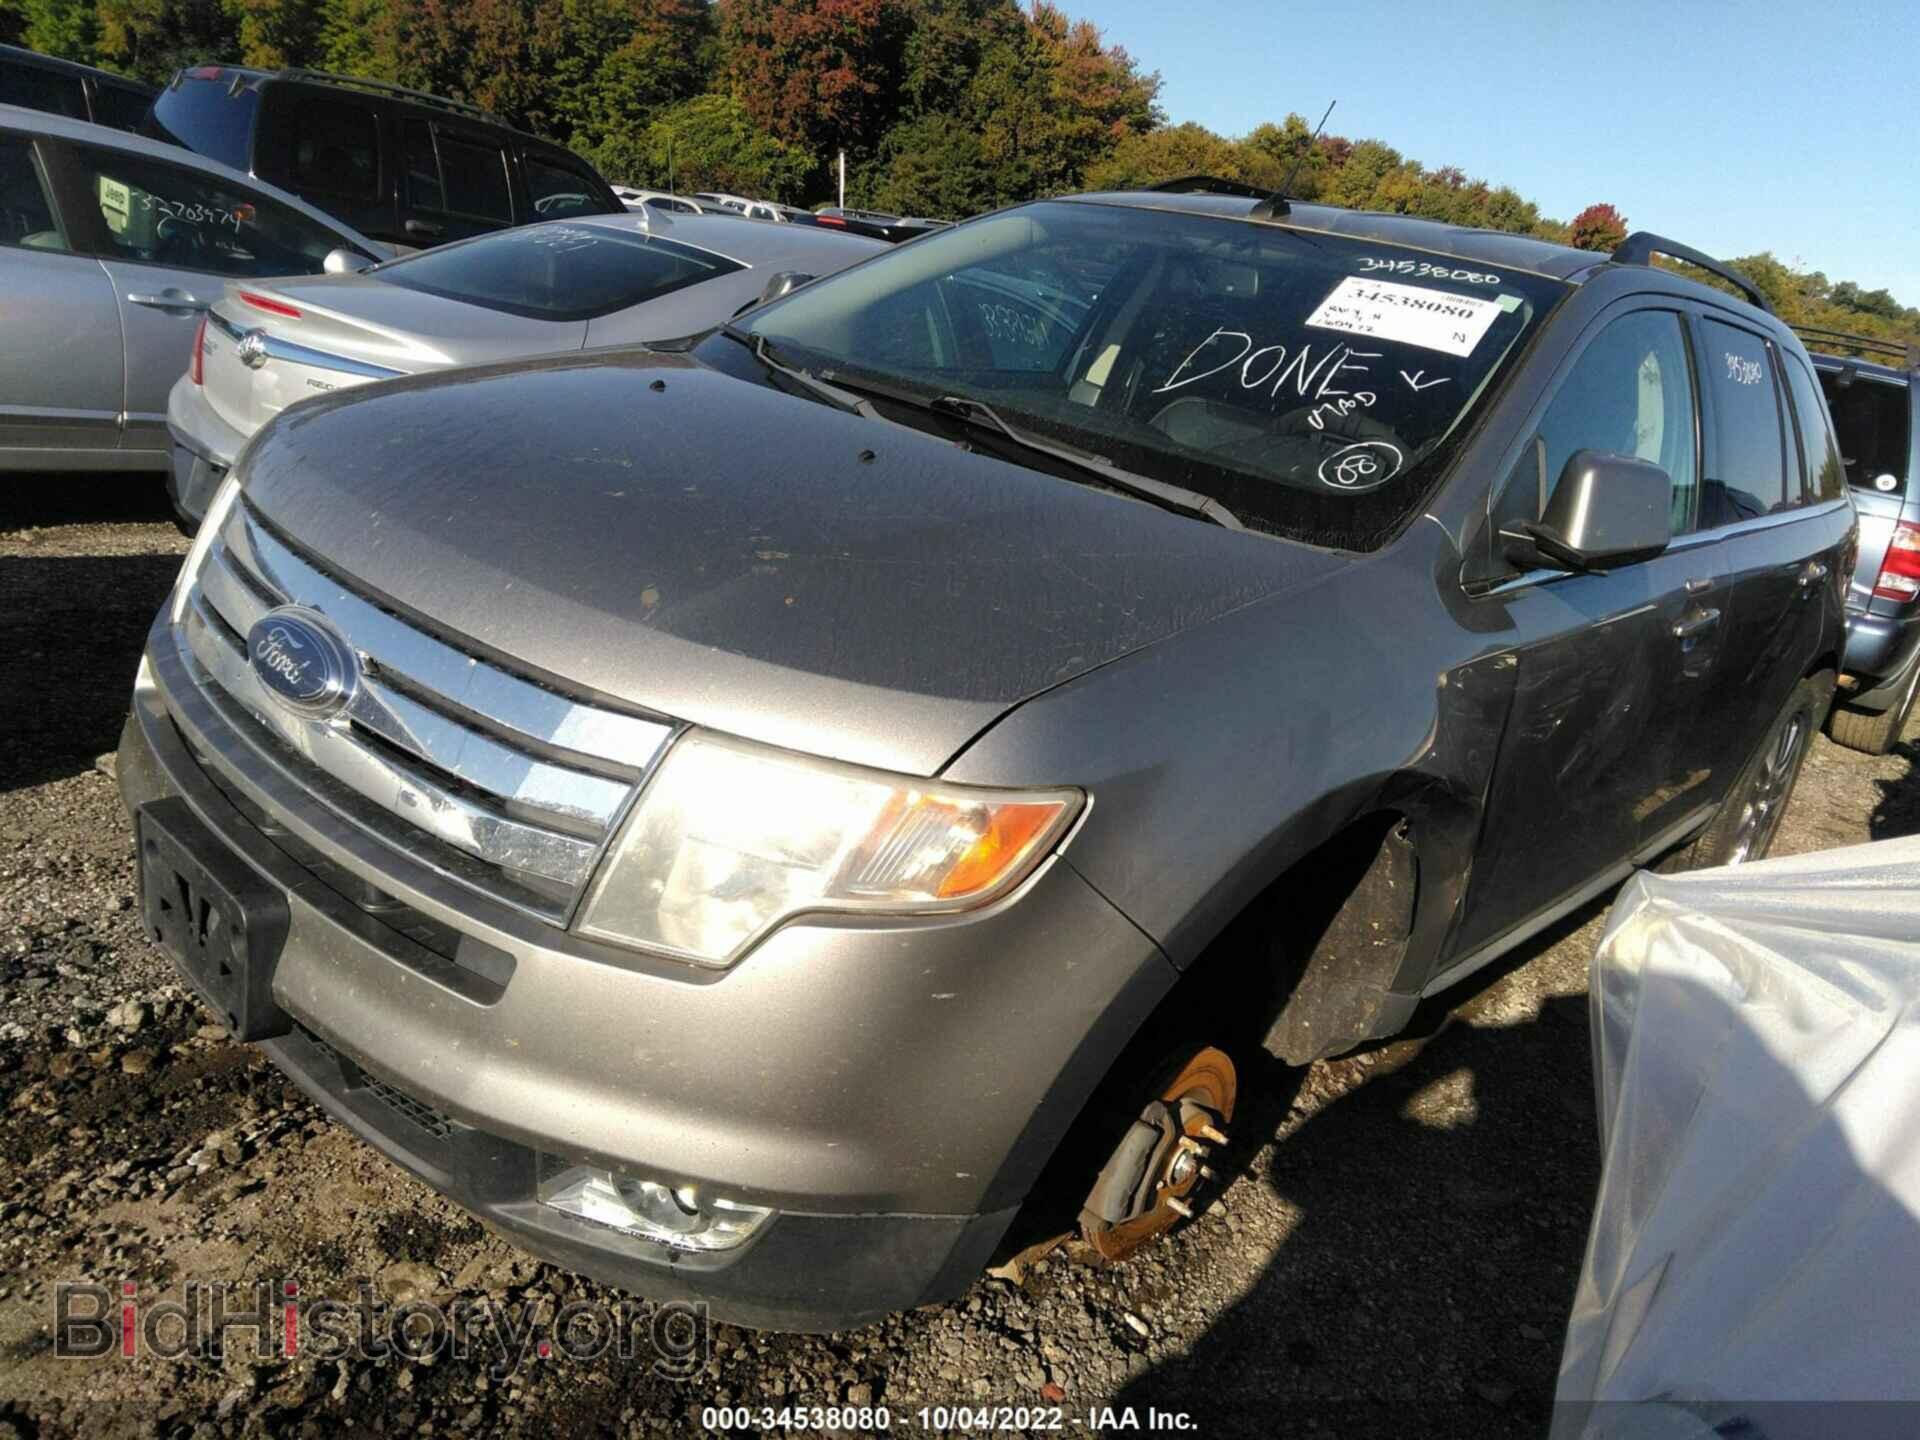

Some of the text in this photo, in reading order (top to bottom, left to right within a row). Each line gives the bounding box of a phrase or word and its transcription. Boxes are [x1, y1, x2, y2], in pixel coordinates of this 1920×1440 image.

[1357, 257, 1501, 285] 34538080
[1347, 288, 1474, 320] 34538080
[1152, 327, 1383, 400] DONE
[255, 626, 312, 685] Ford
